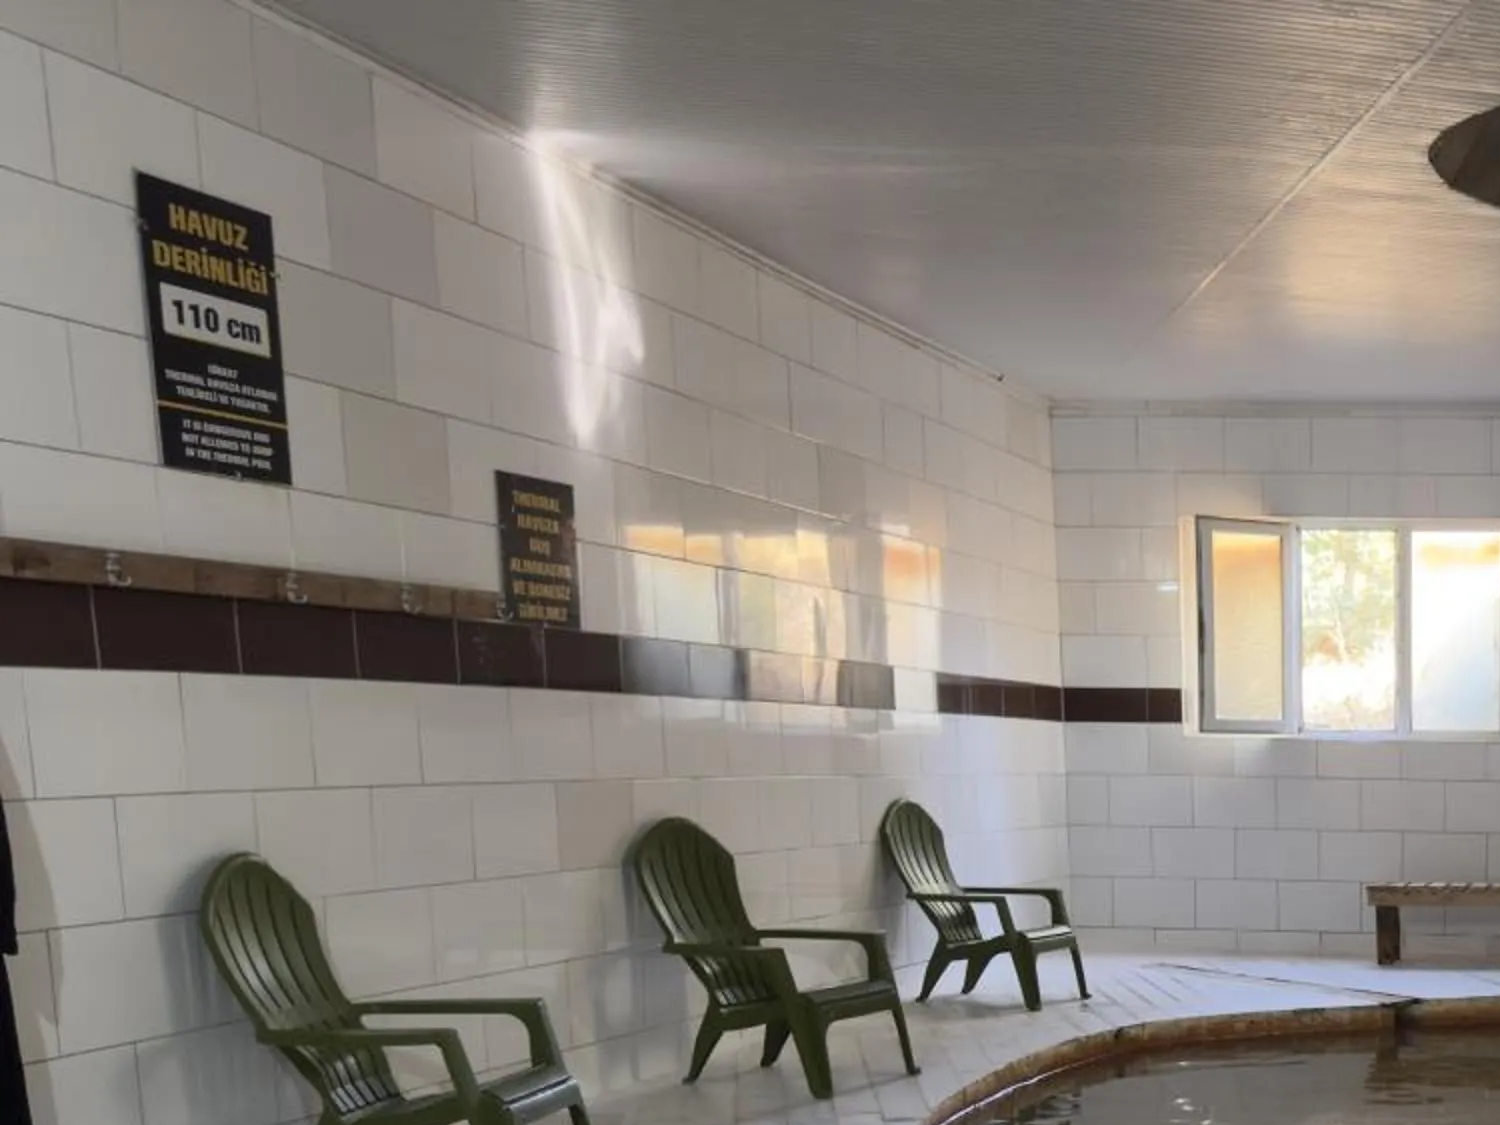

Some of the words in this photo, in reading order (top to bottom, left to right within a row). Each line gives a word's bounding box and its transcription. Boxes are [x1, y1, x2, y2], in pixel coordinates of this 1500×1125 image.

[169, 203, 248, 250] HAVUZ
[153, 239, 268, 295] DERİNLİĞİ
[172, 300, 219, 333] 110
[227, 319, 261, 344] cm
